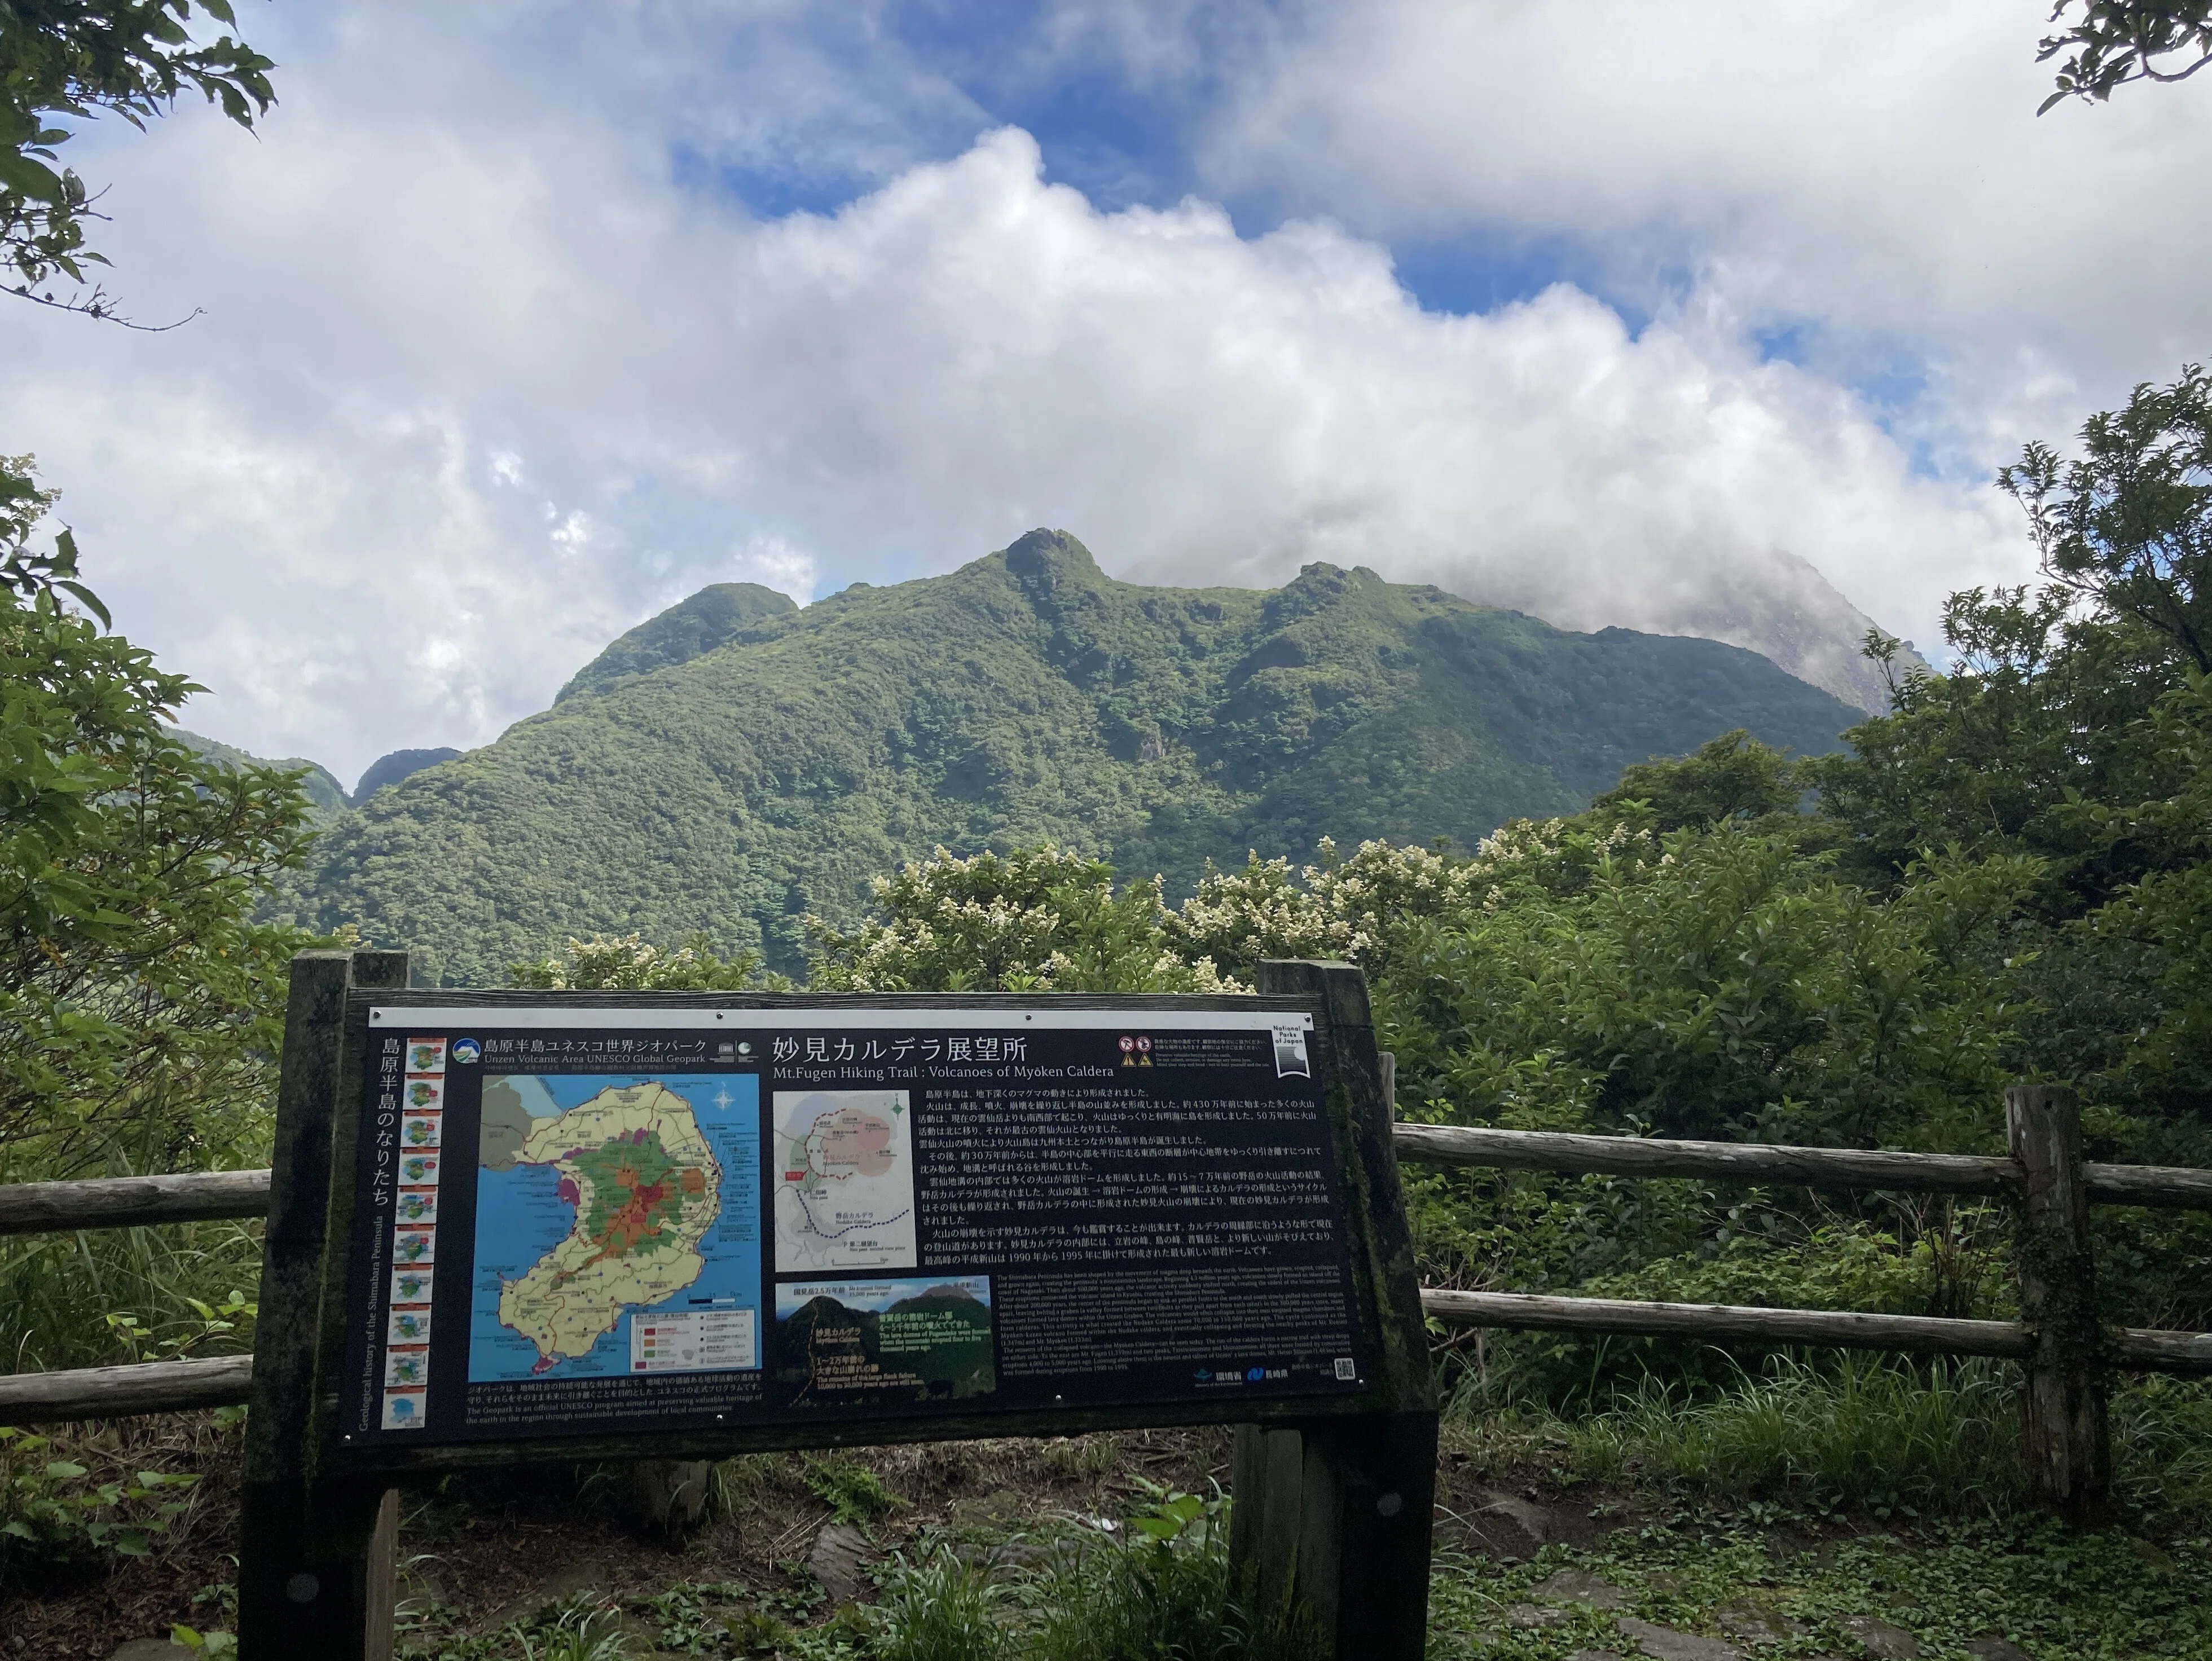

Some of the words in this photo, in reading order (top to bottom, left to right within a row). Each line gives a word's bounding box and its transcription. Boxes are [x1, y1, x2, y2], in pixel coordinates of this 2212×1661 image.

[484, 1039, 706, 1053] 島原半島ユネスコ世界ジオパーク
[666, 1054, 705, 1064] Geopark
[772, 1036, 1027, 1063] 妙見カルデラ展望所
[841, 1066, 883, 1082] Hiking
[888, 1066, 916, 1078] Trail
[930, 1065, 992, 1078] Volcanoes
[997, 1065, 1008, 1078] of
[1067, 1065, 1113, 1078] Caldera
[373, 1037, 400, 1206] 島原半島のなりたち
[922, 1215, 969, 1226] されました。
[372, 1216, 384, 1258] Peninsula
[368, 1262, 380, 1309] Shimabara
[367, 1313, 376, 1327] the
[363, 1344, 376, 1376] history
[359, 1380, 373, 1430] Geological
